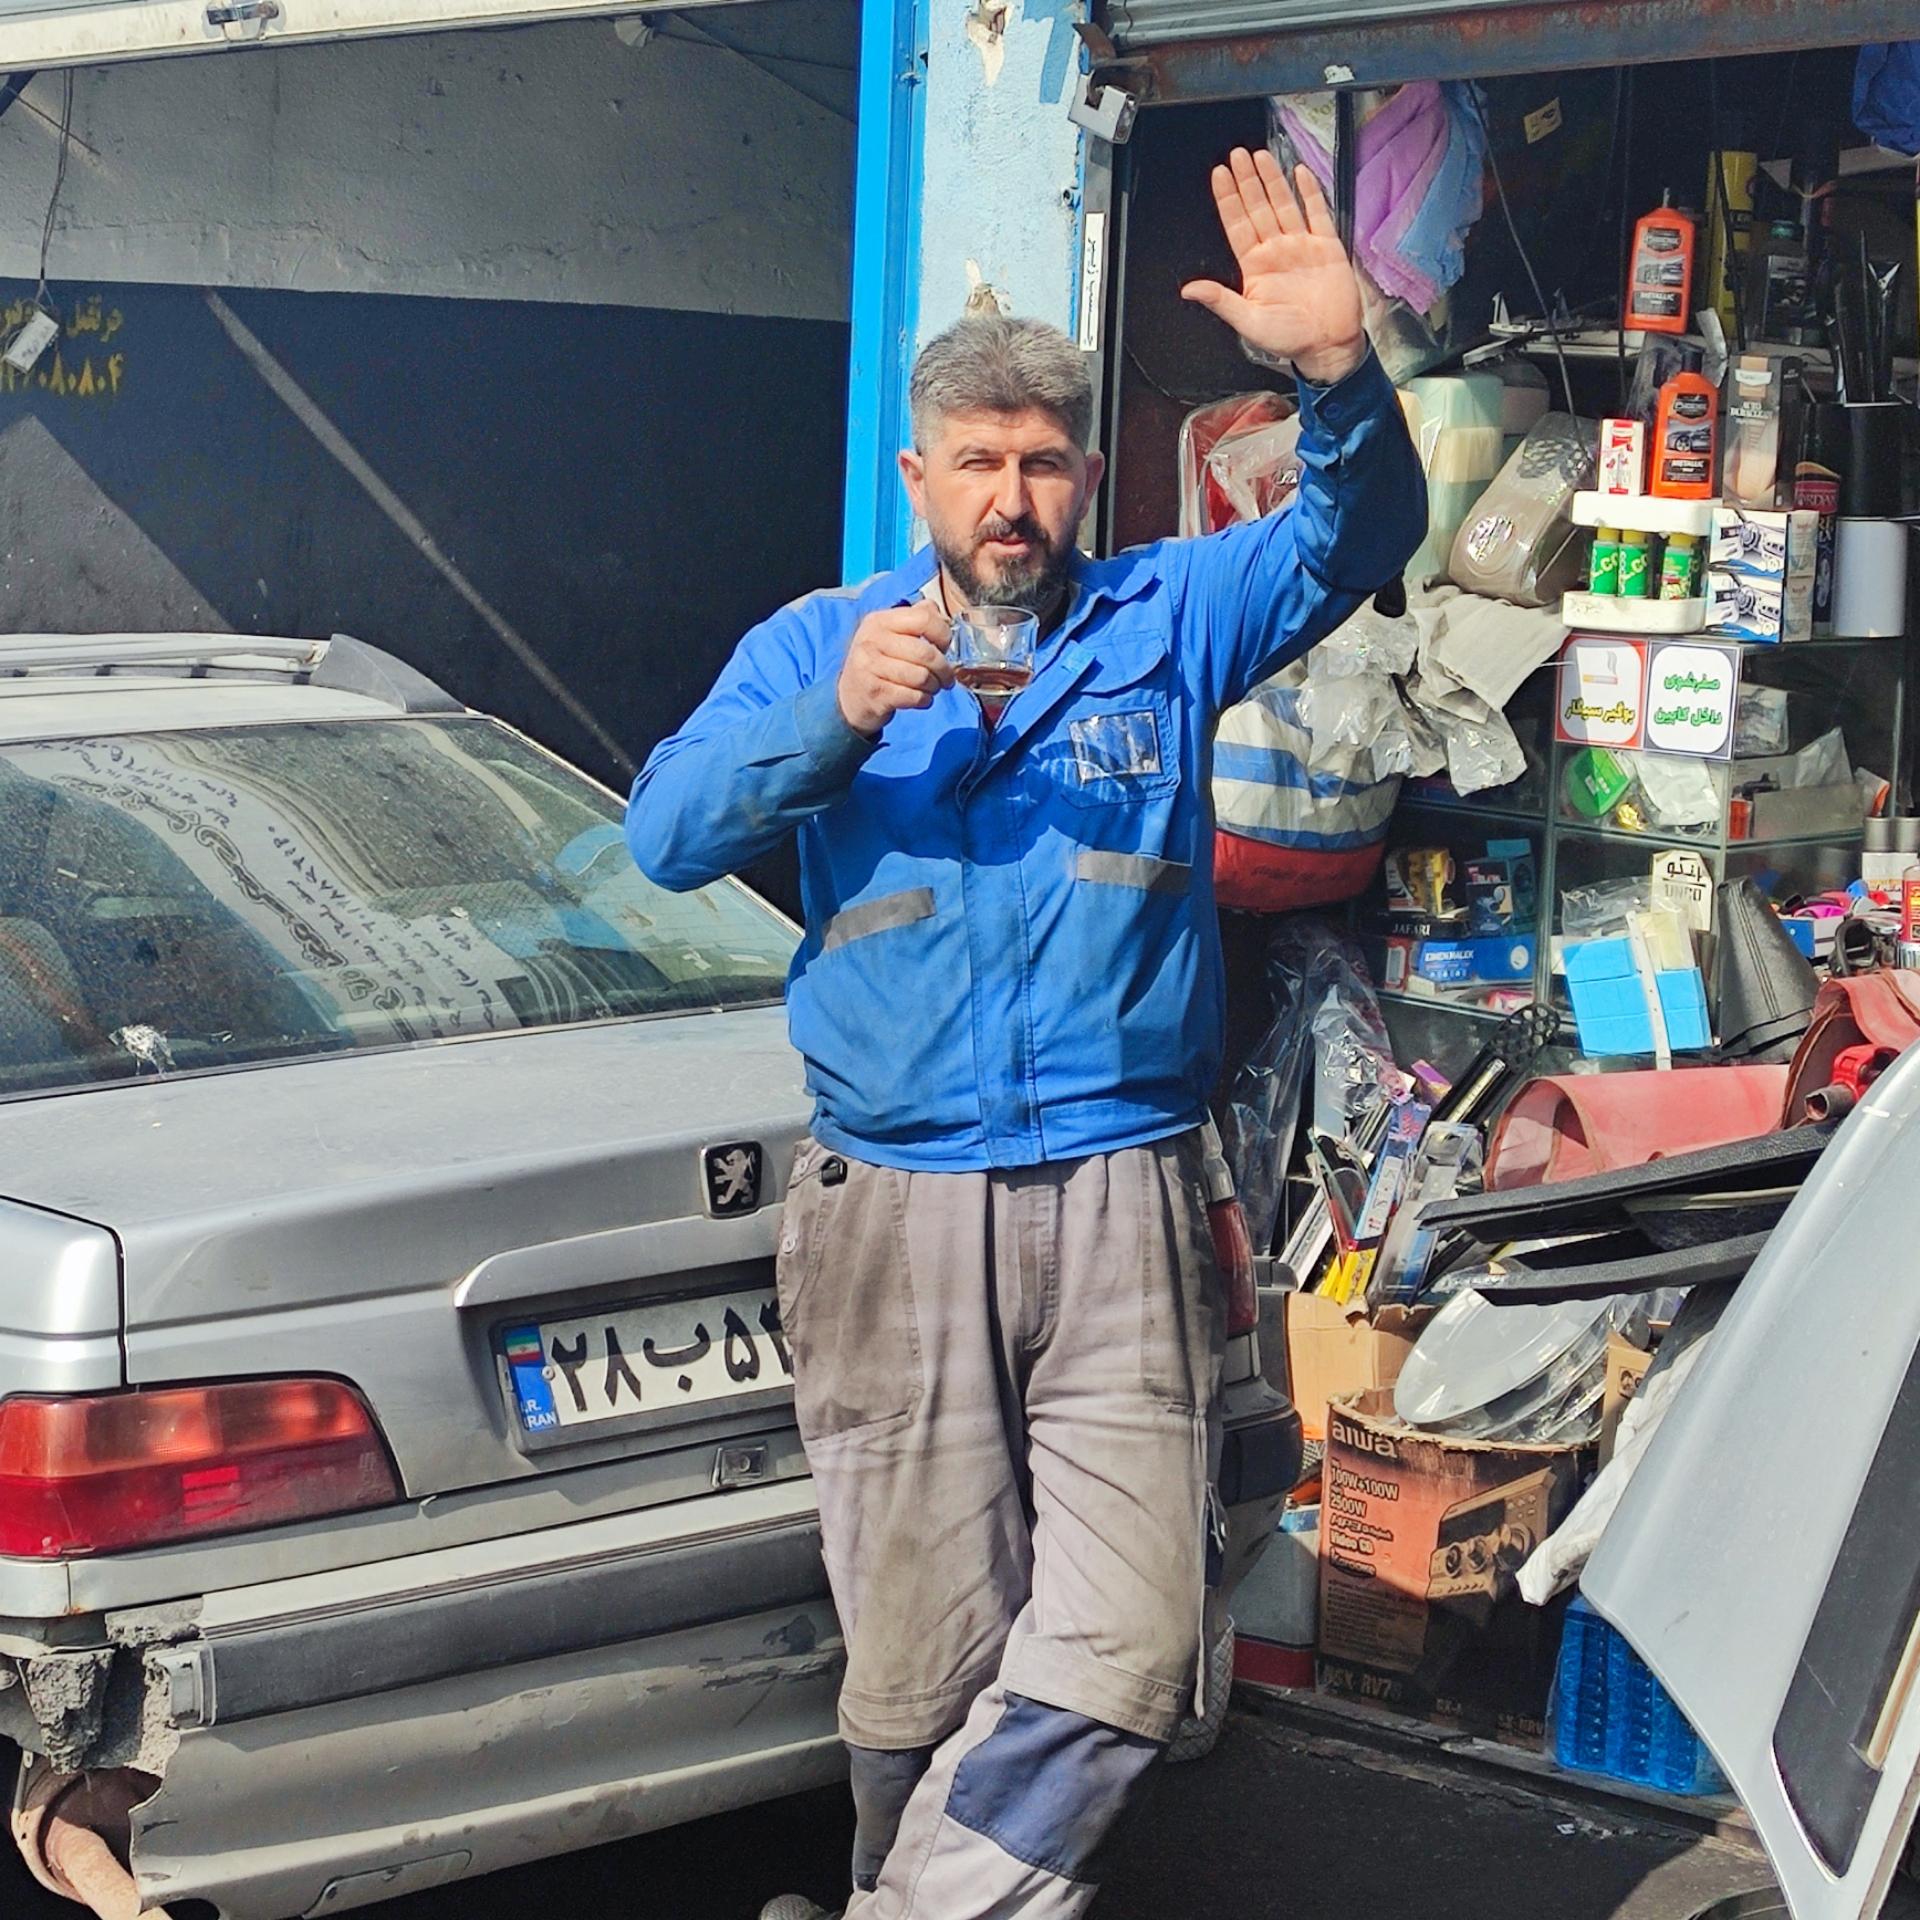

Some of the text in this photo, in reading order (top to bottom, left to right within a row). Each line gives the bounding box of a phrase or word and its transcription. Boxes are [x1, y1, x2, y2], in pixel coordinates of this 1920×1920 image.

[1565, 697, 1602, 720] سیگار
[1653, 705, 1723, 727] داخل کابین
[1332, 1420, 1397, 1459] aiwa
